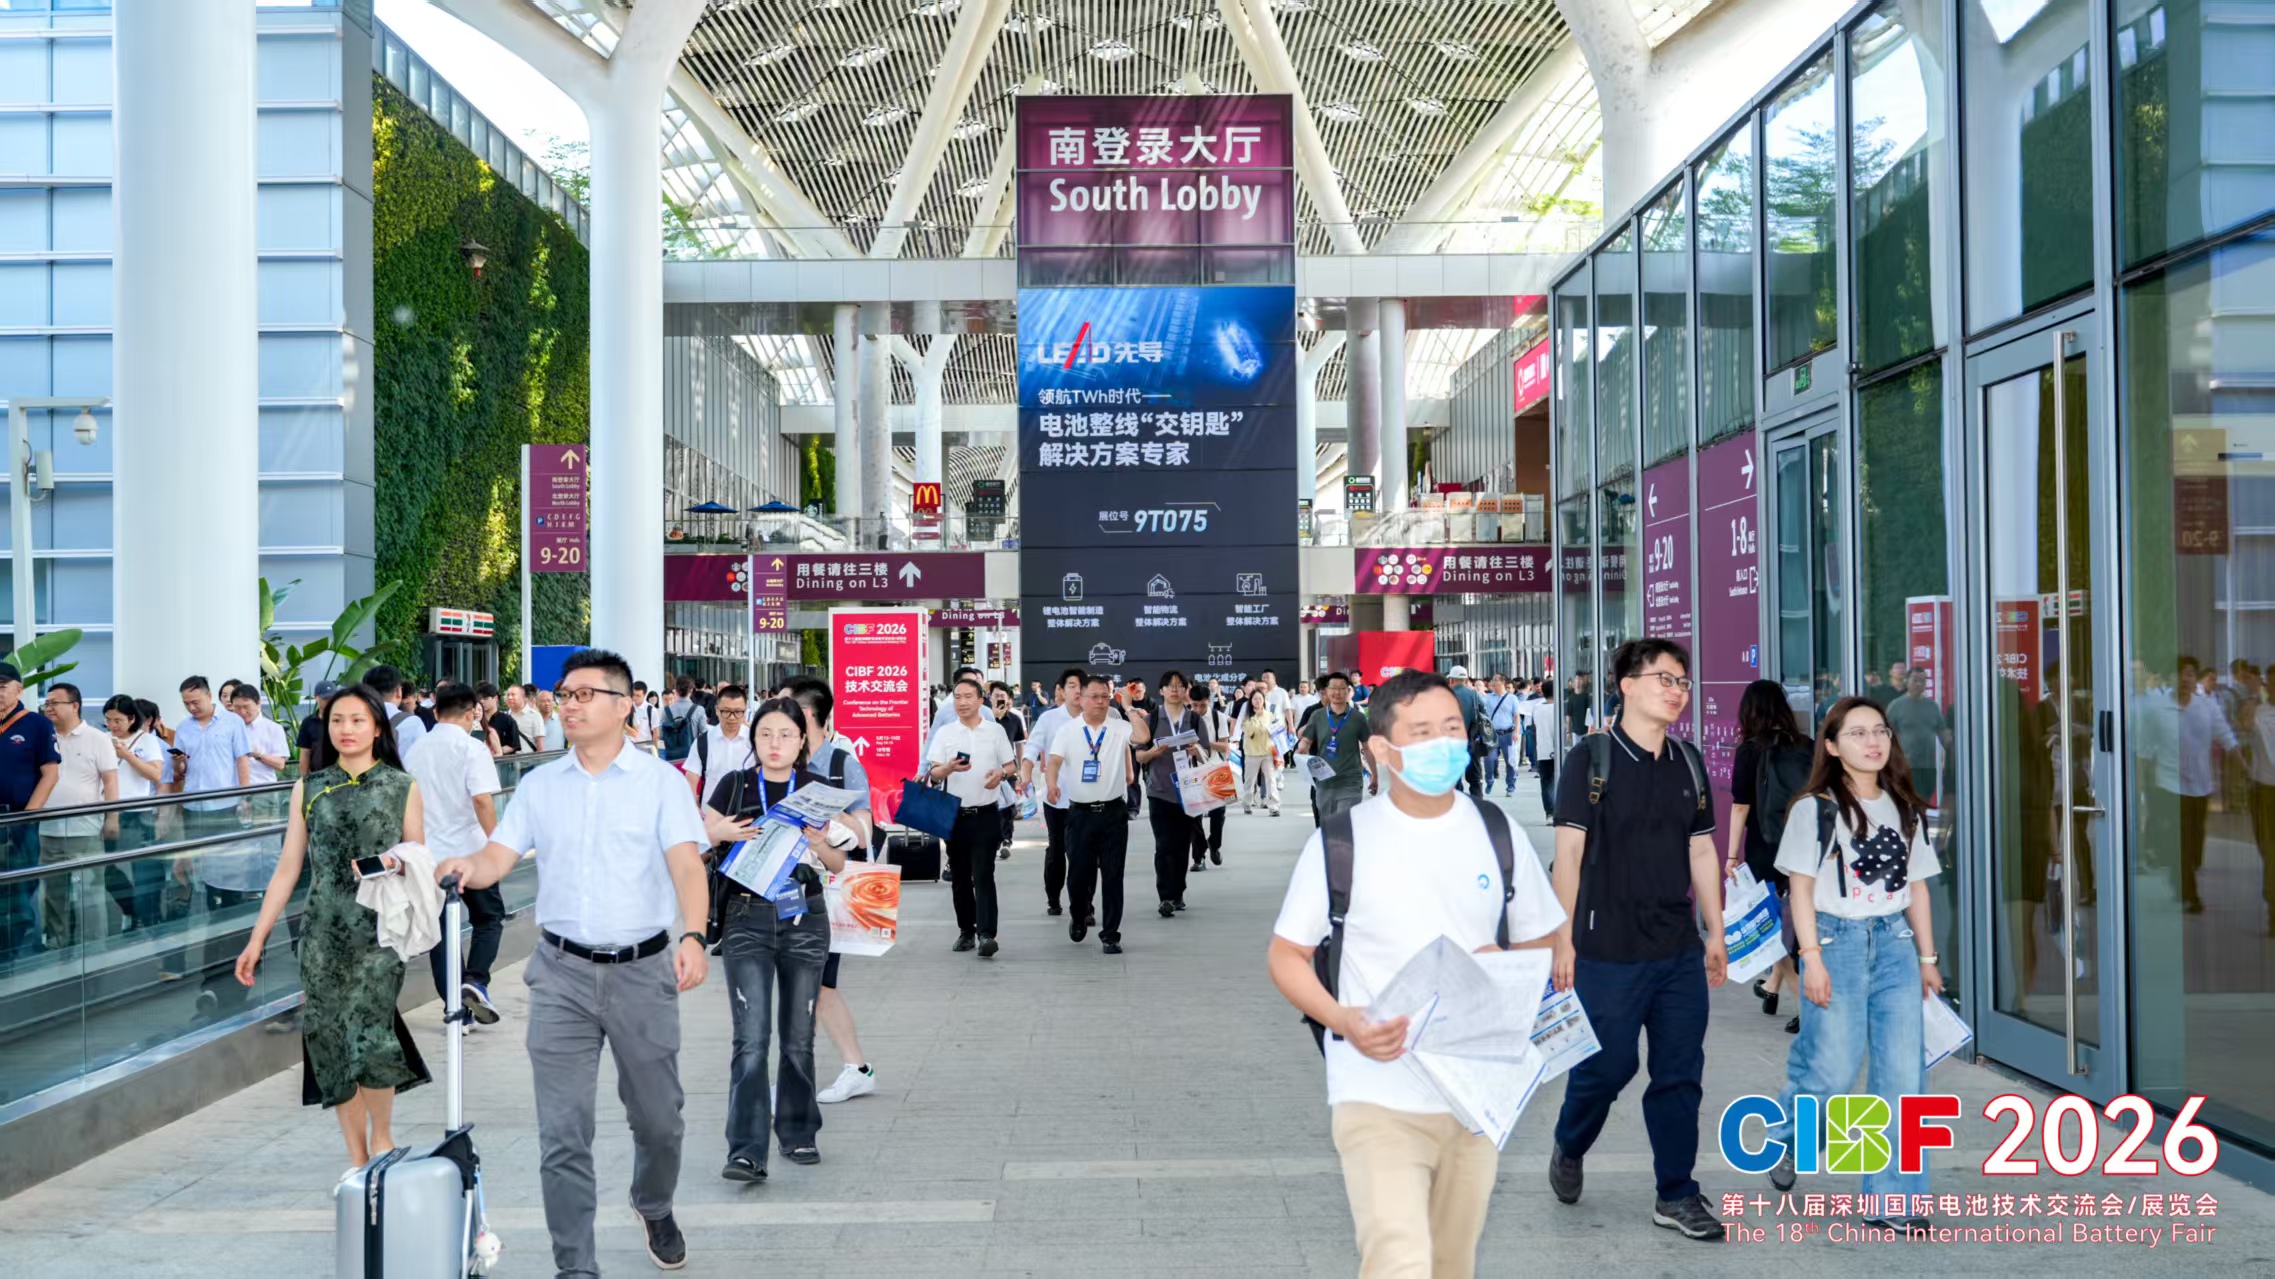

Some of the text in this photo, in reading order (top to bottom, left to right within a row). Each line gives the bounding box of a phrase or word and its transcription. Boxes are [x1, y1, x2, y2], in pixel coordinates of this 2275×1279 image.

[1048, 125, 1262, 166] 南登录大厅
[1049, 175, 1262, 221] South Lobby
[1113, 341, 1165, 363] 先导
[1039, 411, 1244, 438] 电池整线“交钥匙”
[1038, 441, 1191, 467] 解决方案专家
[1098, 511, 1129, 522] 展位号
[1133, 509, 1208, 533] 9T075
[1731, 516, 1747, 557] 1-8
[540, 546, 581, 565] 9-20
[1654, 534, 1674, 572] 9-20
[797, 562, 889, 577] 用餐请往三楼
[1443, 555, 1535, 570] 用餐请往三楼
[796, 577, 844, 591] Dining
[848, 579, 867, 588] on
[872, 577, 889, 589] L3
[1443, 570, 1535, 584] Dining on L3
[760, 617, 785, 629] 9-20
[941, 611, 975, 621] Dining
[844, 623, 907, 635] CIBF 2026
[845, 665, 908, 677] CIBF 2026
[845, 680, 909, 693] 技术交流会
